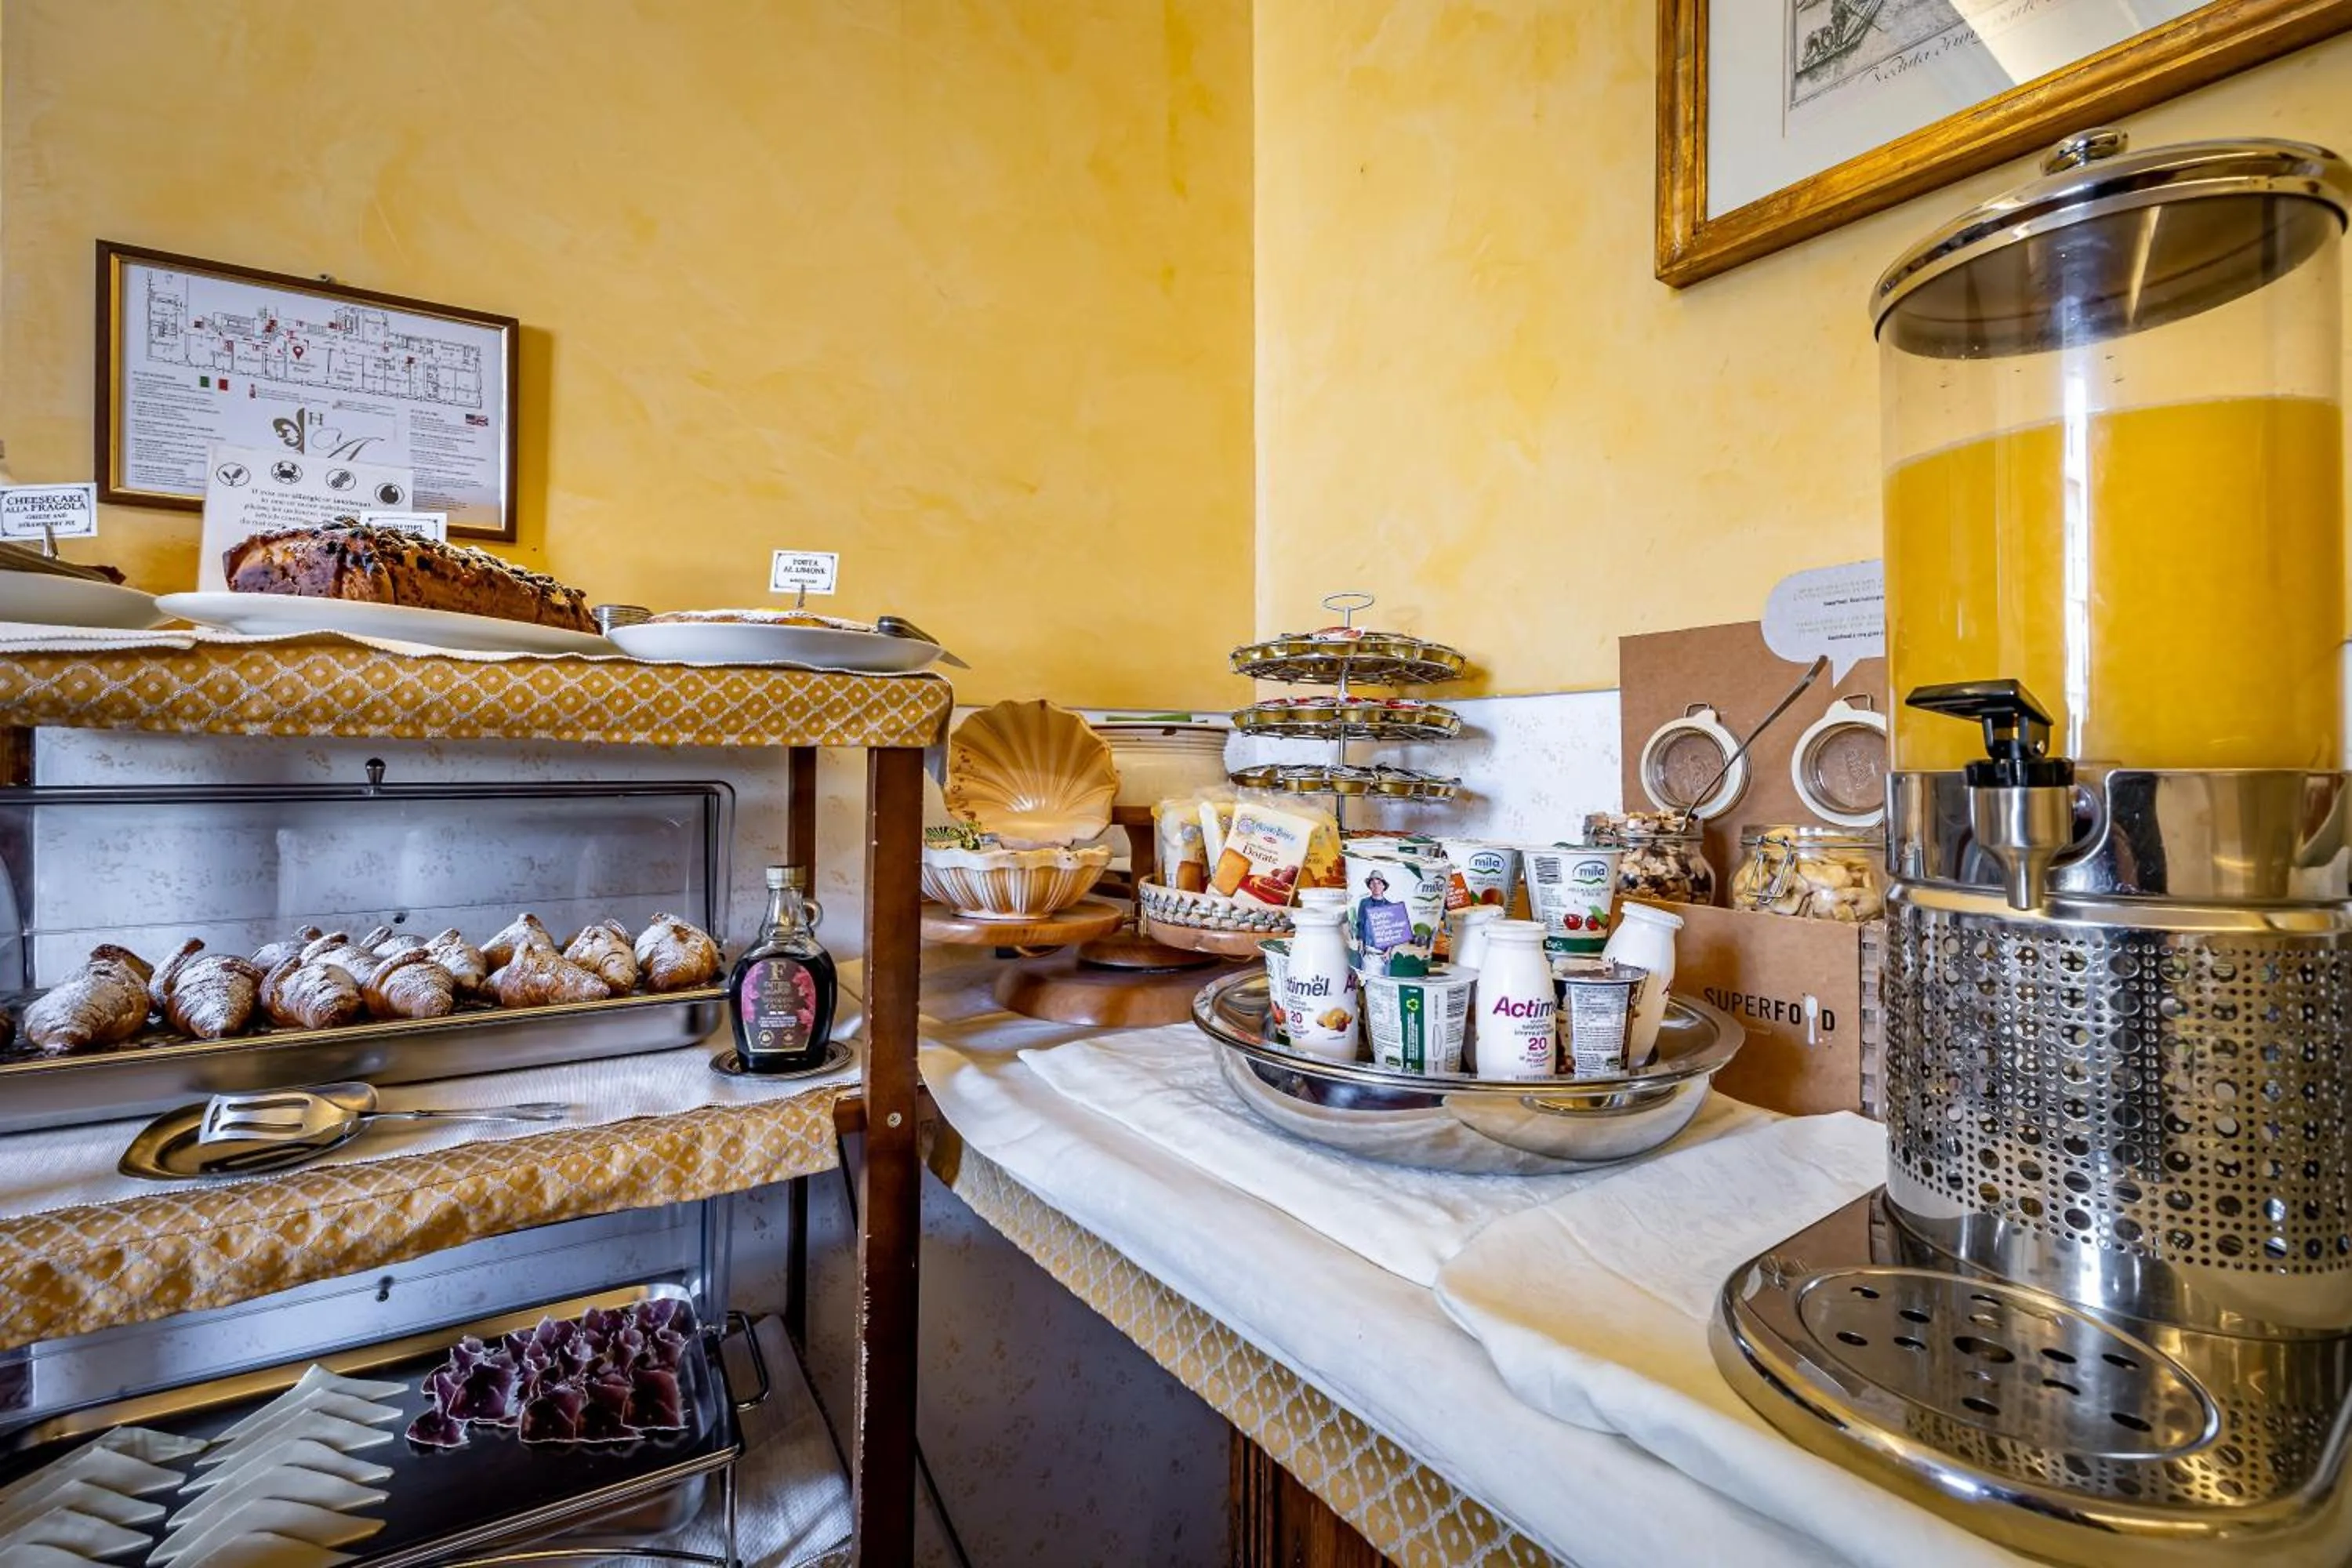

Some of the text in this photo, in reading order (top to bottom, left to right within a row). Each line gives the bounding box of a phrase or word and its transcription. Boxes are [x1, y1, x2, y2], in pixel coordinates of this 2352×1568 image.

[309, 412, 324, 426] H
[6, 494, 84, 505] CHEESECAKE
[31, 503, 86, 512] FRAGOLA
[1242, 844, 1279, 865] Dorate
[1475, 856, 1501, 867] mila
[1579, 865, 1605, 877] mila
[1421, 882, 1443, 893] mila
[1287, 975, 1330, 996] timel
[1493, 995, 1555, 1018] Actim
[1290, 1011, 1302, 1023] 20
[1528, 1036, 1547, 1051] 20
